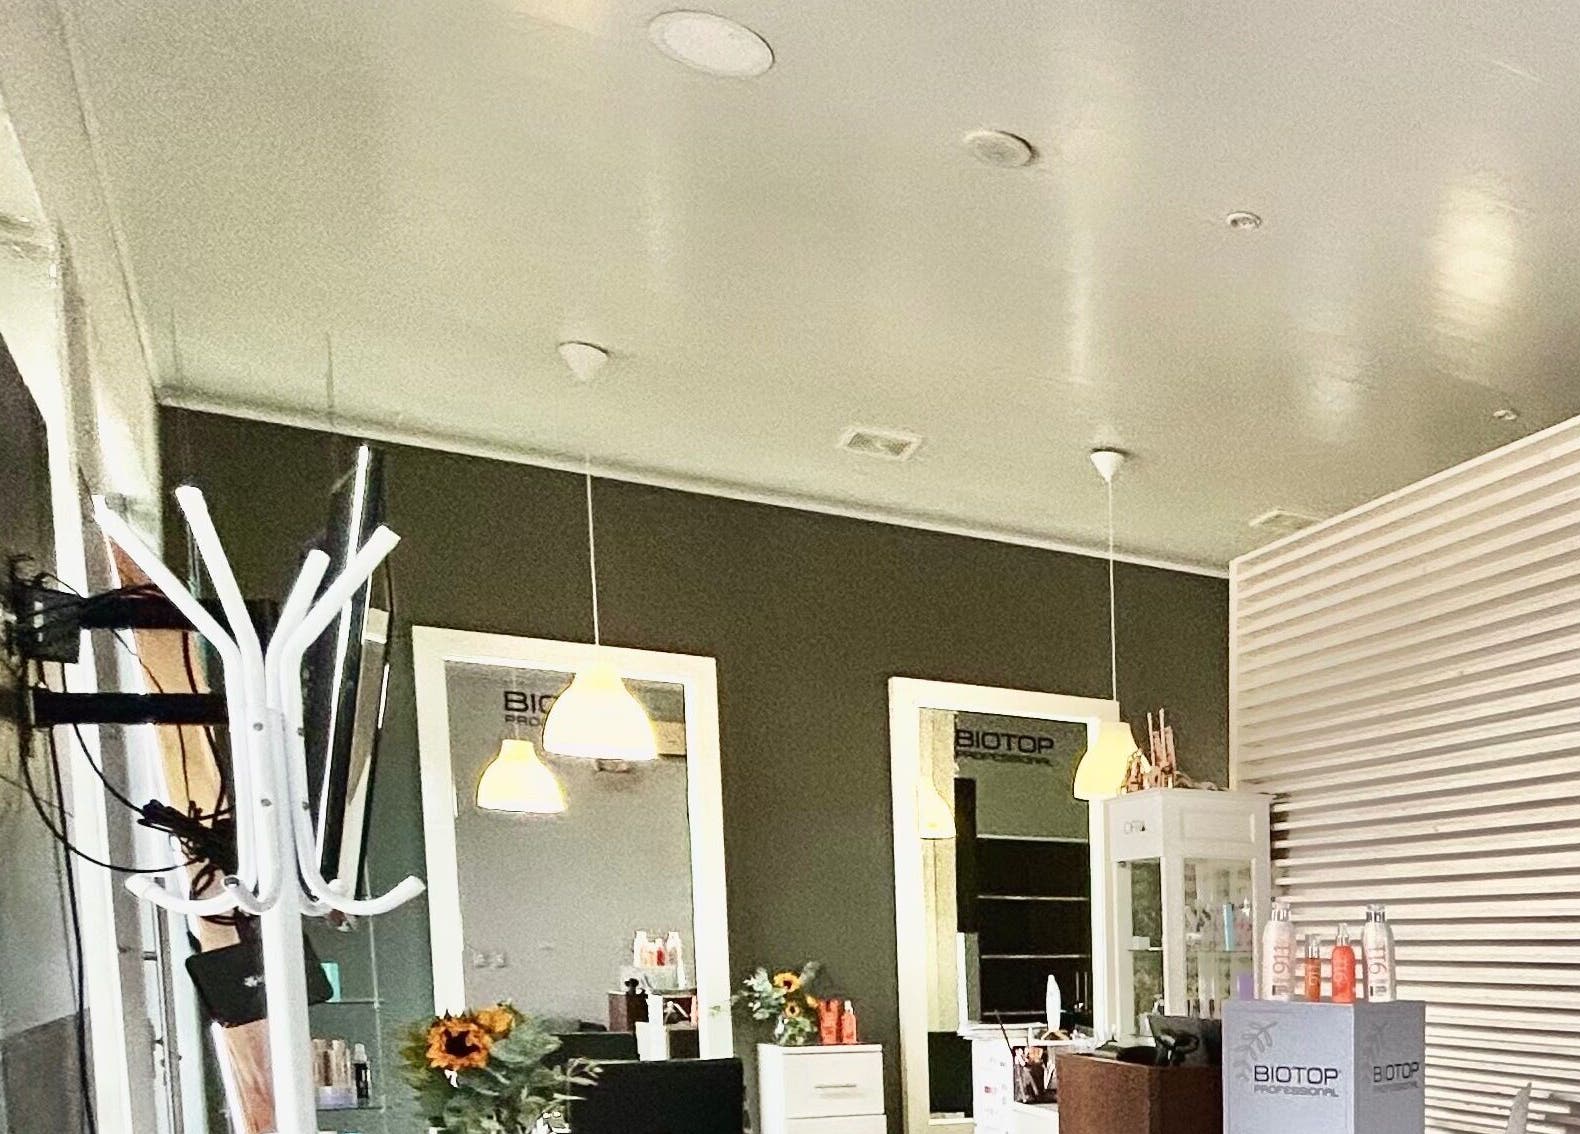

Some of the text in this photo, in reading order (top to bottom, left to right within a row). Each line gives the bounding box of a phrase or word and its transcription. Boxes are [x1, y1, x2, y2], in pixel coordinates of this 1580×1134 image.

[956, 728, 1055, 754] BIOTOP
[1254, 1064, 1339, 1085] BIOTOP
[1373, 1061, 1419, 1083] BIOTOP
